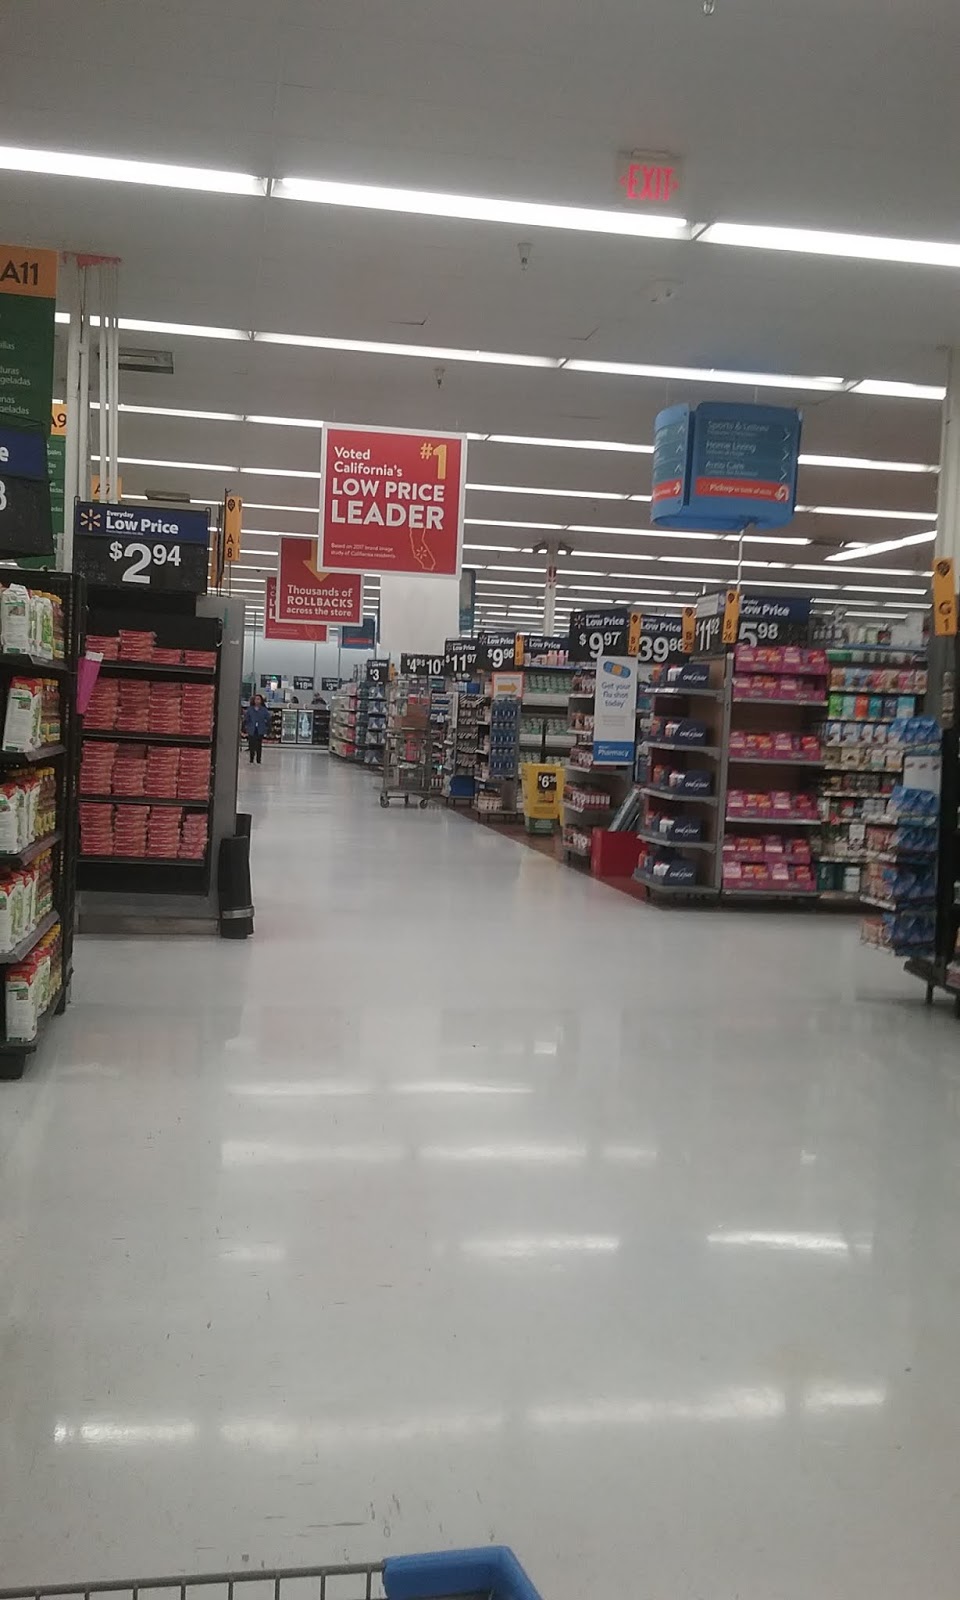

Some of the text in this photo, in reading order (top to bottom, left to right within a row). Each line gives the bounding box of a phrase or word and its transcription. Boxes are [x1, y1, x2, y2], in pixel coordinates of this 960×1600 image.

[627, 163, 675, 202] EXIT
[0, 260, 38, 285] A11
[334, 446, 371, 460] Voted
[334, 461, 403, 477] California's
[332, 477, 445, 502] LOW PRICE
[106, 510, 134, 519] Everyday
[331, 499, 444, 530] LEADER
[106, 516, 139, 531] Low
[140, 518, 179, 534] Price
[287, 584, 339, 597] Thousands
[341, 588, 353, 597] of
[287, 596, 353, 608] ROLLBACKS
[286, 607, 312, 615] across
[314, 607, 328, 616] the
[762, 603, 790, 616] Price
[586, 615, 625, 626] Low Price
[640, 621, 682, 633] Low Price
[487, 637, 499, 645] Low
[601, 681, 613, 689] Get
[598, 748, 630, 757] Pharmacy
